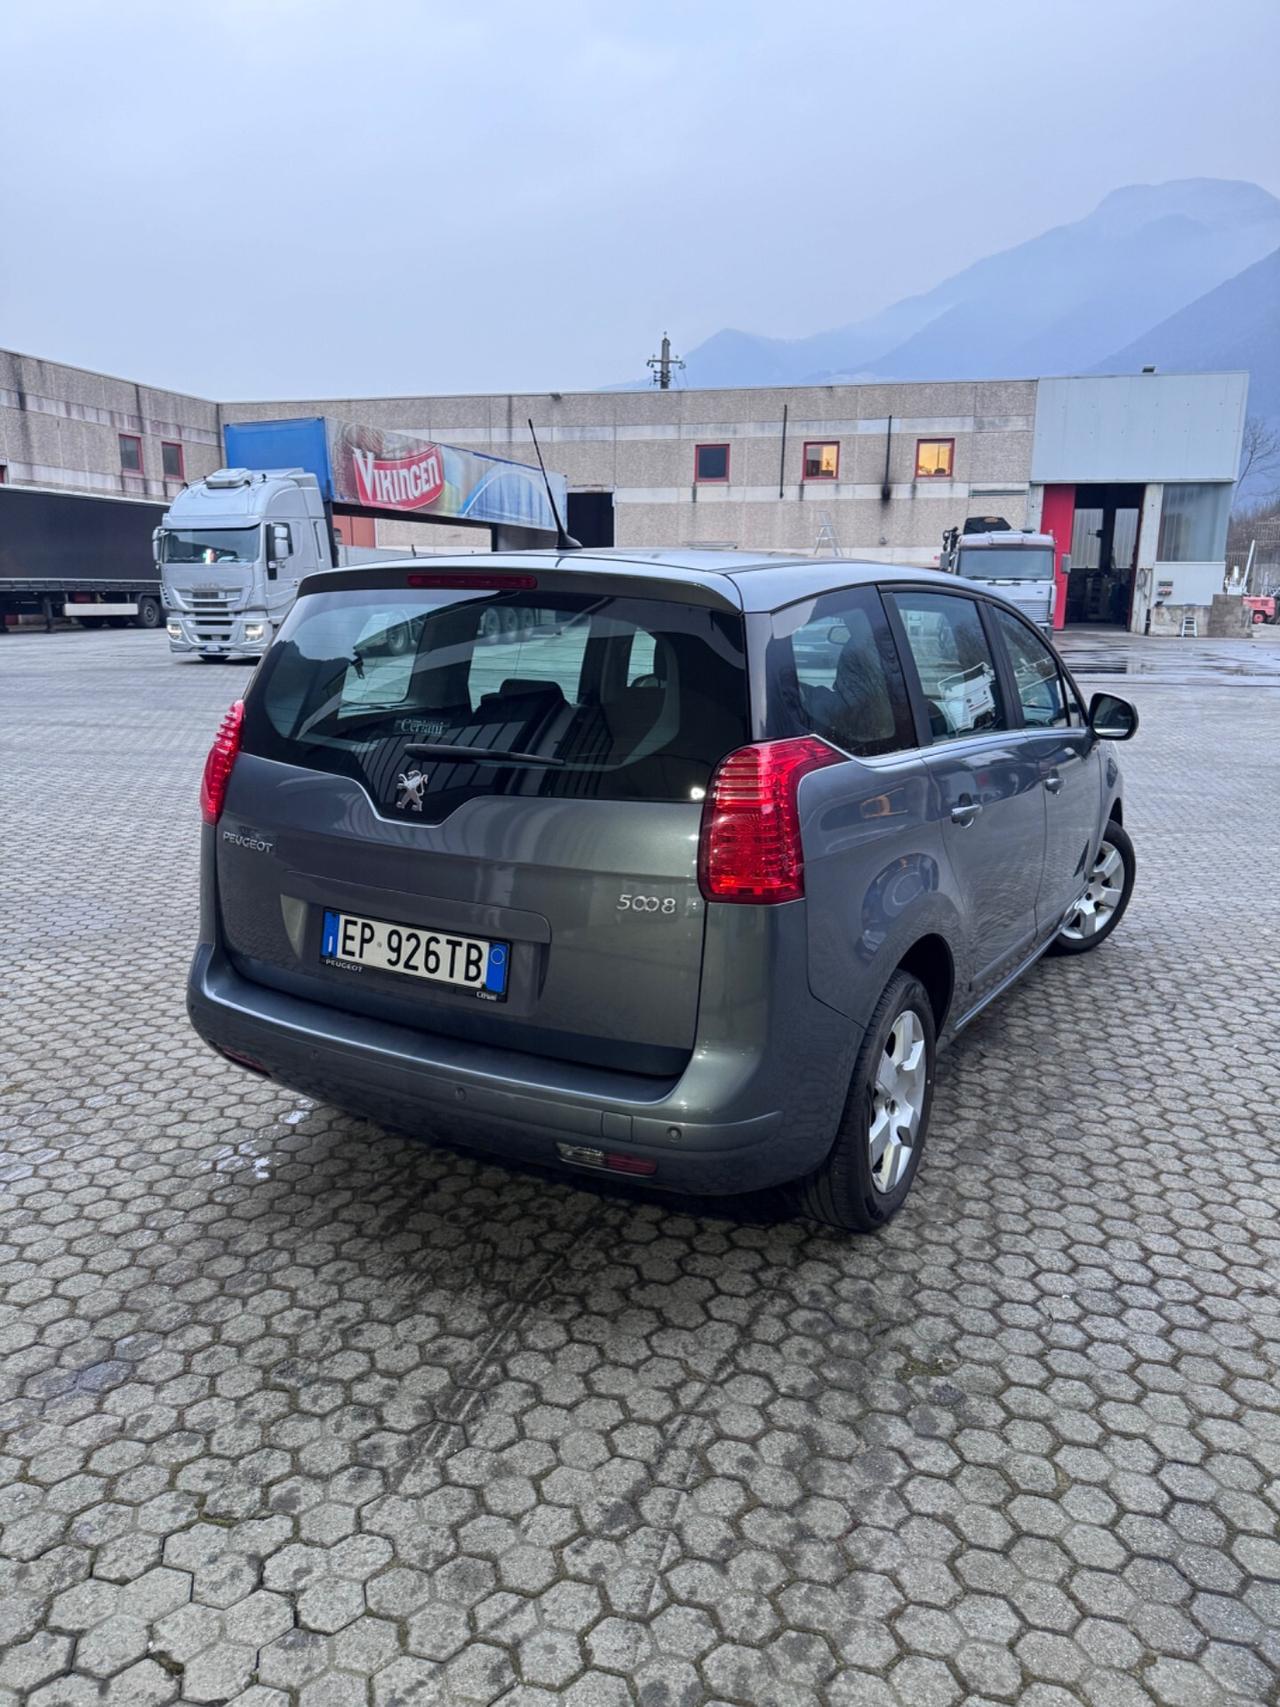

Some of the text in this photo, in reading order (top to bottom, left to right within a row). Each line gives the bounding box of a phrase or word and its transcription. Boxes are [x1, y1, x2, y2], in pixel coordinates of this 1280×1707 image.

[223, 831, 273, 853] PEUGEOT
[616, 894, 676, 914] 5008
[341, 918, 484, 983] EP 926TB
[325, 959, 363, 972] PEUGEOT
